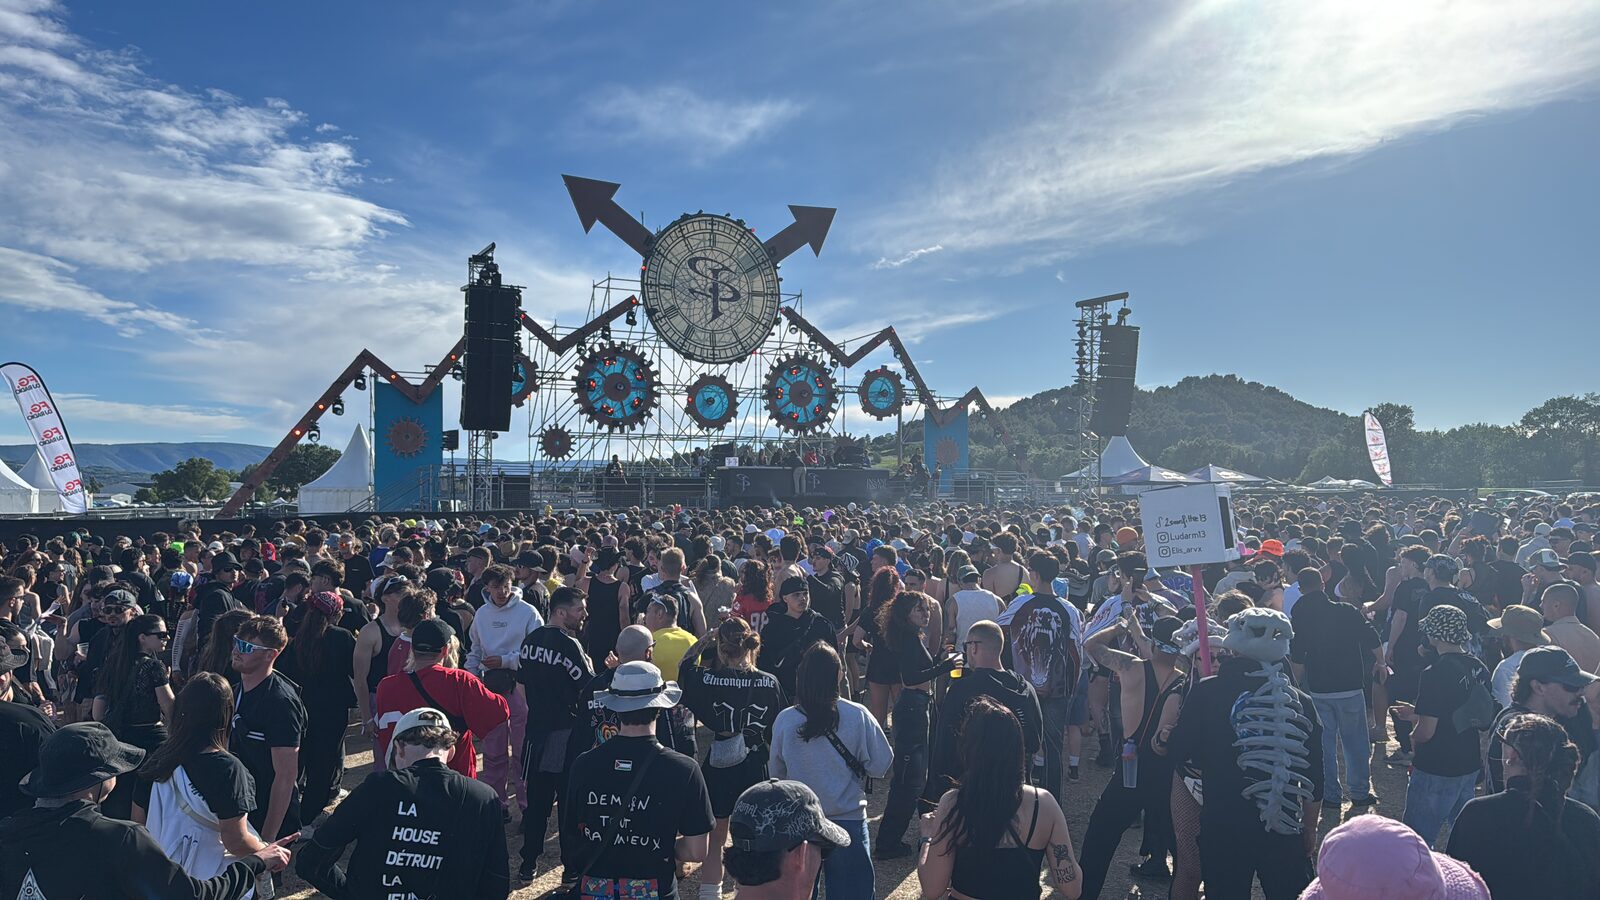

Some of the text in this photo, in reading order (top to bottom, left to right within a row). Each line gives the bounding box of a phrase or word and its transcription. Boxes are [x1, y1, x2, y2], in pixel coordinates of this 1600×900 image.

[1170, 530, 1206, 541] Ludarm13
[520, 644, 582, 680] QUENARD
[398, 801, 417, 817] LA
[600, 815, 631, 828] TUT
[392, 826, 441, 845] HOUSE
[613, 833, 661, 850] MIEUX
[385, 849, 443, 870] DÉTRUIT
[382, 874, 402, 886] LA
